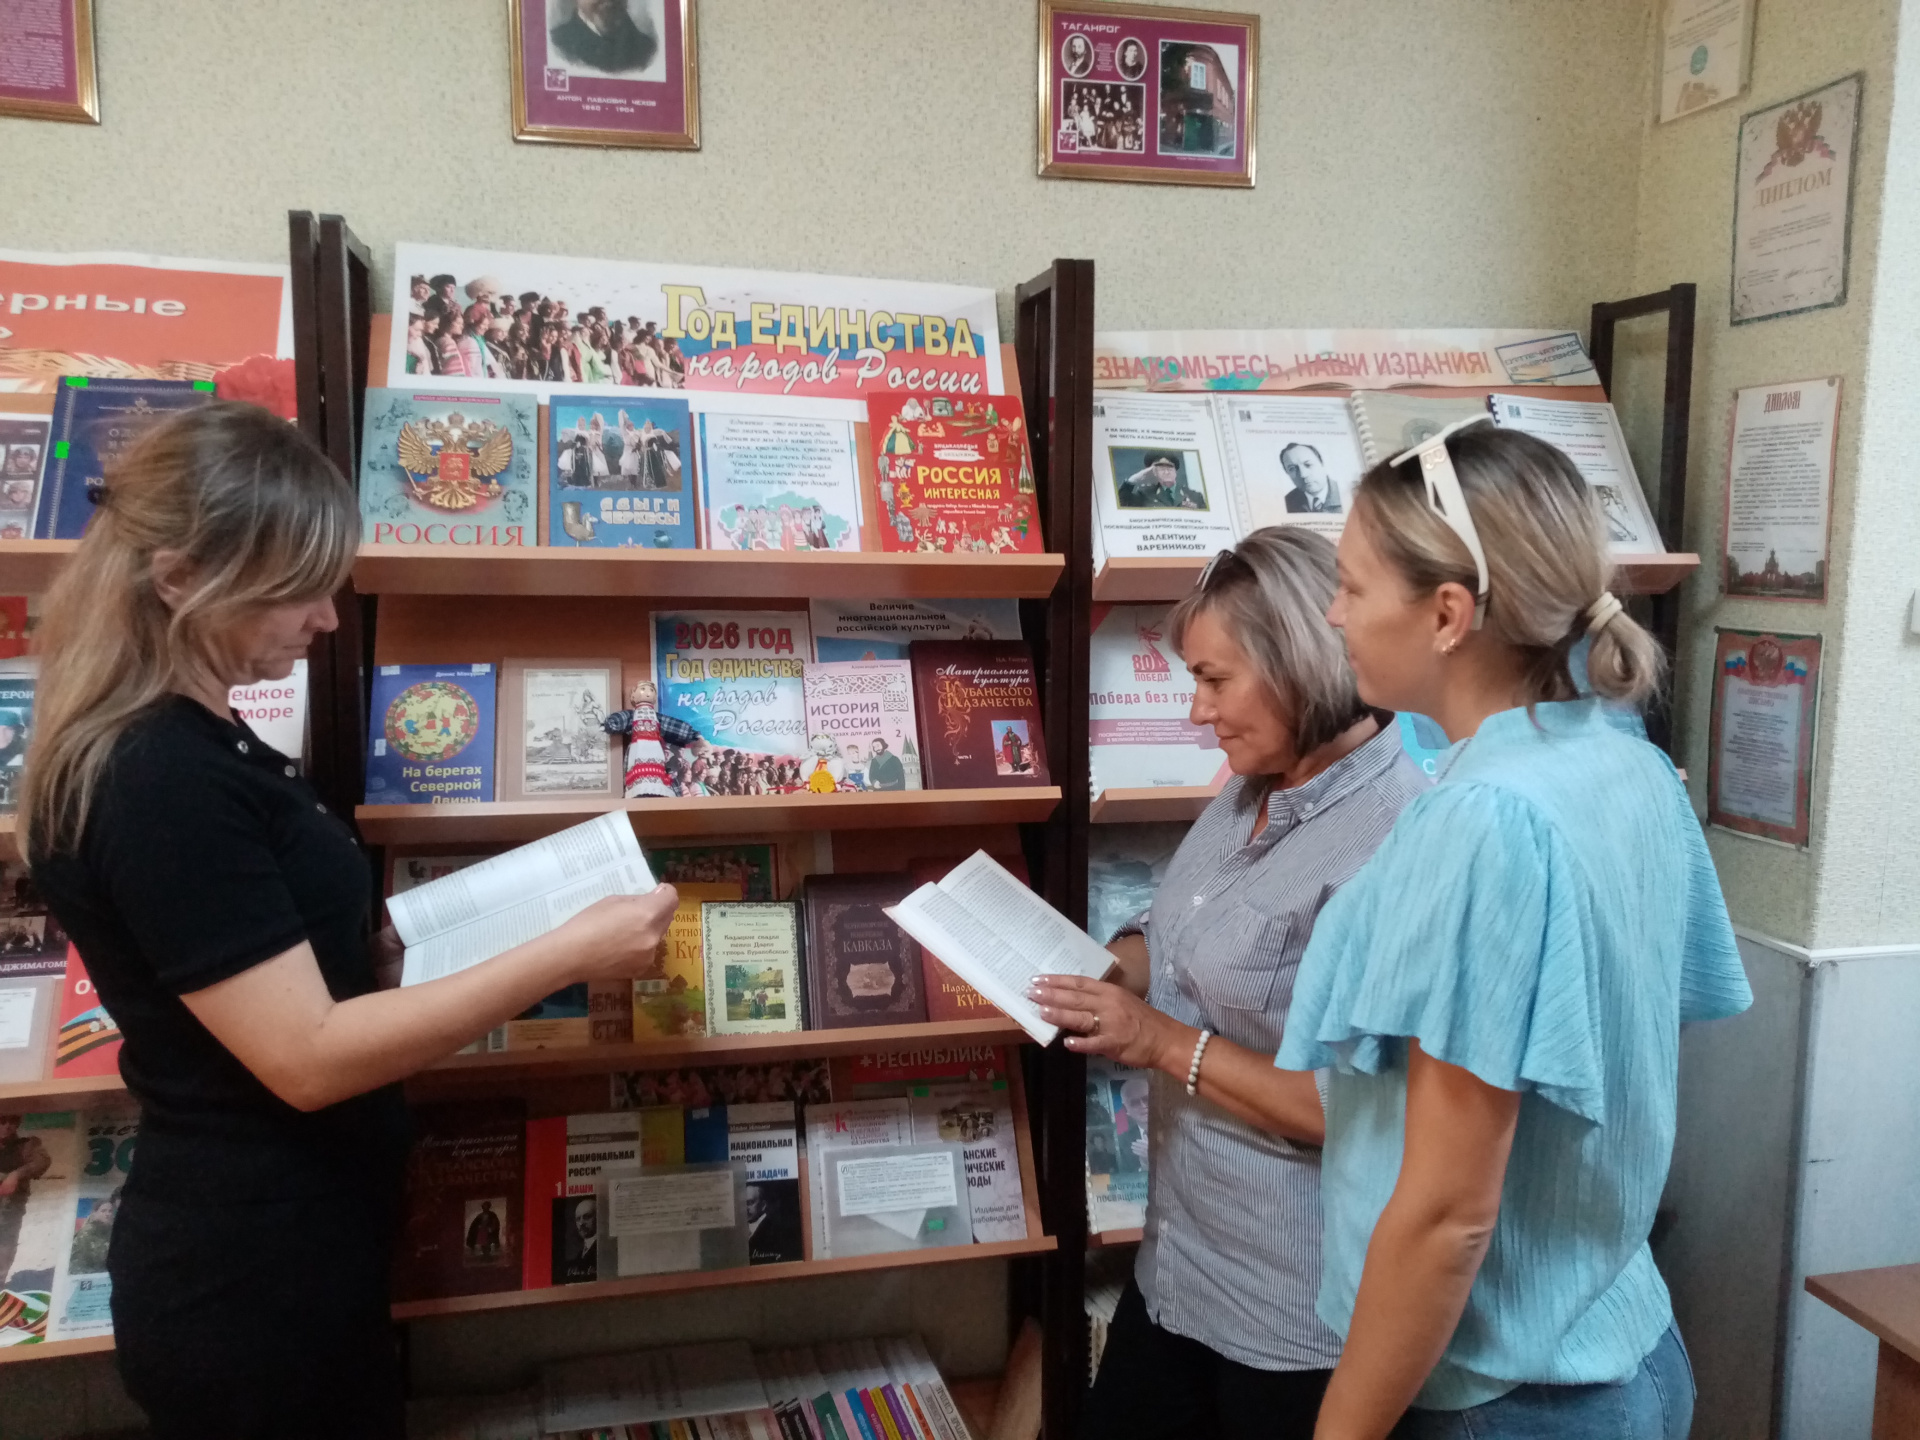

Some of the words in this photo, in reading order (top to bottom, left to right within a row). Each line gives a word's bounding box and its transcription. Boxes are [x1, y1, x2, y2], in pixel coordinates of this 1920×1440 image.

[1061, 21, 1121, 34] ТАГАНРОГ
[1753, 168, 1833, 209] ДИПЛОМ
[0, 292, 188, 317] рные
[661, 284, 736, 350] Год
[750, 302, 978, 359] ЕДИНСТВА
[688, 347, 841, 394] народов
[855, 348, 982, 395] России
[1294, 351, 1368, 377] НАШИ
[1374, 351, 1492, 379] ИЗДАНИЯ!
[1764, 390, 1801, 413] ДИПЛОМ
[917, 466, 1001, 485] РОССИЯ
[924, 487, 1000, 499] ИНТЕРЕСНАЯ
[600, 497, 680, 511] АДЫГИ
[600, 511, 681, 526] ЧЕРКЕСЫ
[374, 522, 525, 546] РОССИЯ
[869, 603, 914, 611] Величие
[838, 613, 946, 622] многонациональной
[836, 623, 898, 633] российской
[900, 624, 950, 632] культуры
[675, 621, 740, 649] 2026
[747, 627, 794, 654] год
[665, 653, 705, 683] Год
[708, 658, 803, 682] единства
[1132, 654, 1155, 671] 80
[936, 664, 1029, 679] Материальная
[1135, 673, 1172, 682] ПОБЕДА!
[972, 676, 1030, 688] культура
[230, 687, 296, 703] ецкое
[677, 680, 777, 713] народов
[1089, 692, 1140, 705] Победа
[1145, 691, 1168, 703] без
[1173, 692, 1194, 705] гра
[810, 702, 879, 716] ИСТОРИЯ
[712, 710, 807, 737] России
[821, 717, 880, 730] РОССИИ
[402, 766, 421, 778] На
[425, 765, 482, 778] берегах
[410, 778, 482, 792] Северной
[843, 939, 893, 953] КАВКАЗА
[876, 1046, 996, 1069] РЕСПУБЛИКА
[730, 1139, 793, 1151] НАЦИОНАЛЬНАЯ
[569, 1150, 635, 1163] НАЦИОНАЛЬНАЯ
[964, 1147, 997, 1160] АНСКИЕ
[757, 1168, 788, 1180] ЗАДАЧИ
[967, 1175, 991, 1188] ЮДЫ
[555, 1182, 562, 1196] 1
[568, 1184, 593, 1194] НАШИ
[972, 1214, 1020, 1224] лабовидящих
